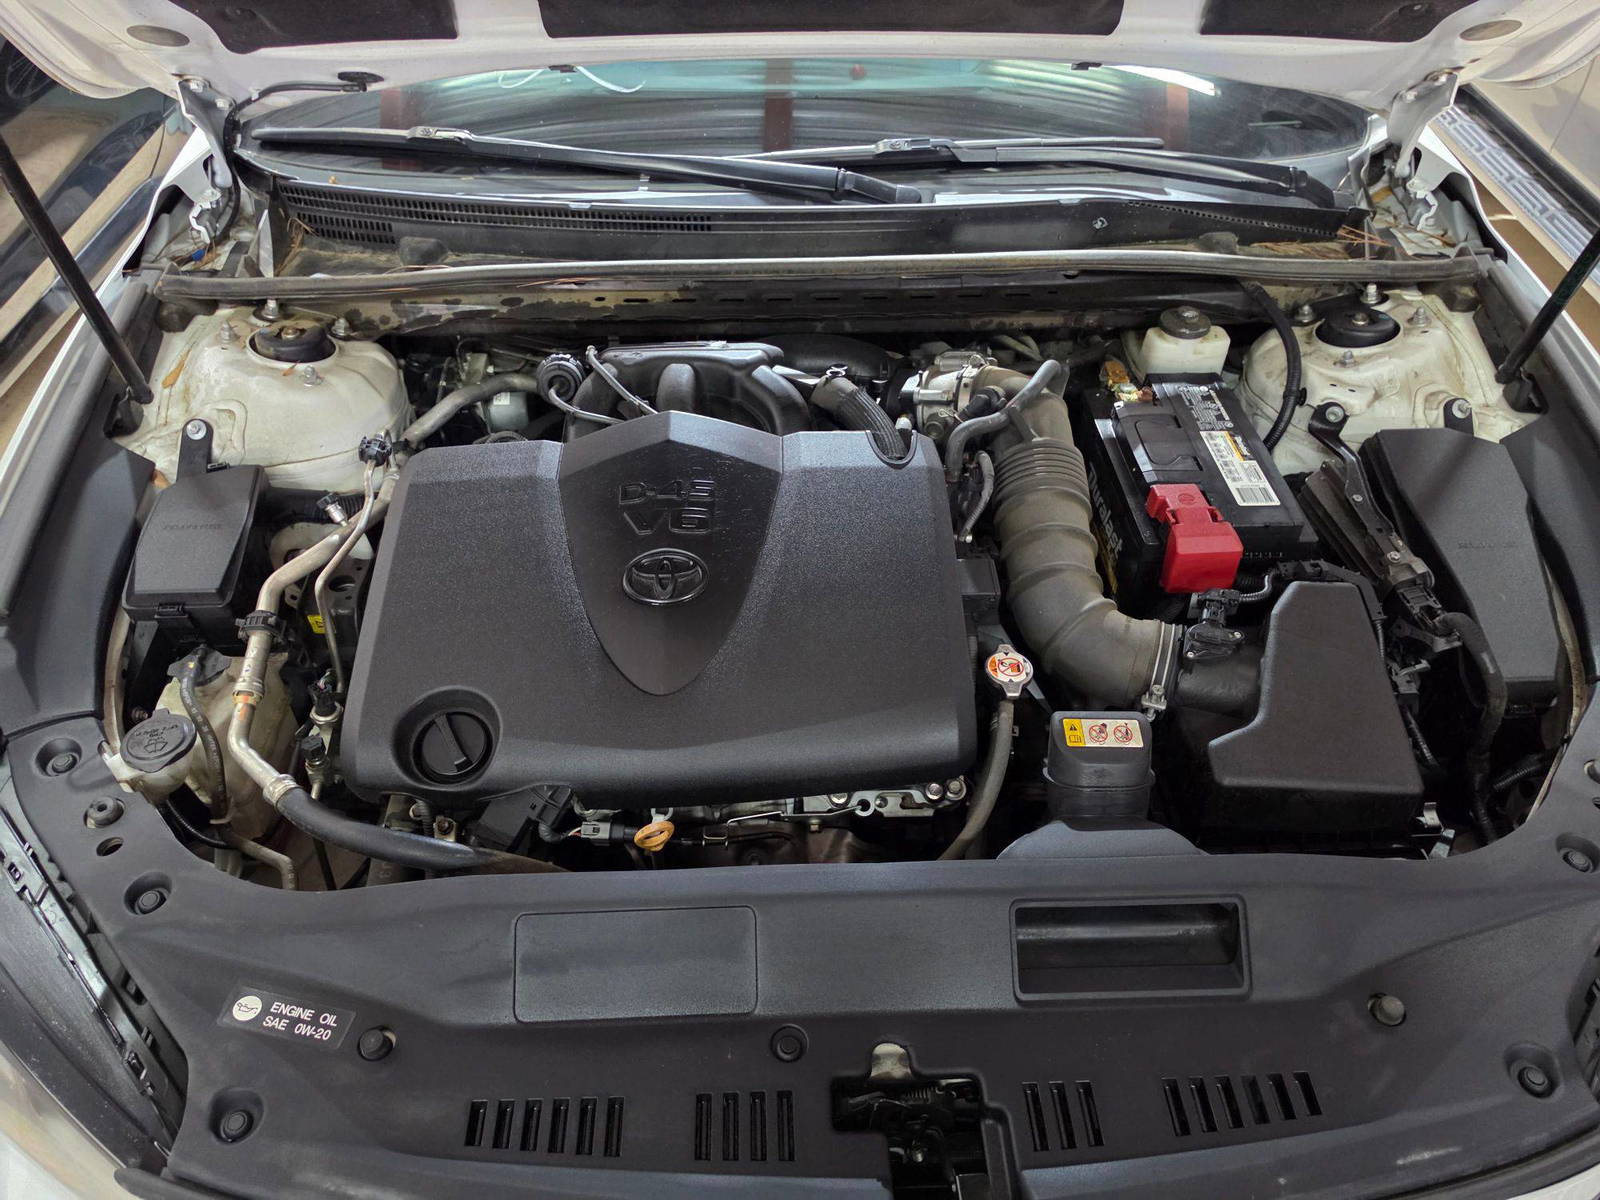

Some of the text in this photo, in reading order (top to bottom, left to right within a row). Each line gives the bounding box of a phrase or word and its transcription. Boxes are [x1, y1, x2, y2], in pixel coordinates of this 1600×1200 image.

[623, 507, 712, 535] V6
[269, 1001, 338, 1027] ENGINE OIL
[262, 1015, 332, 1041] SAE 0W-20
